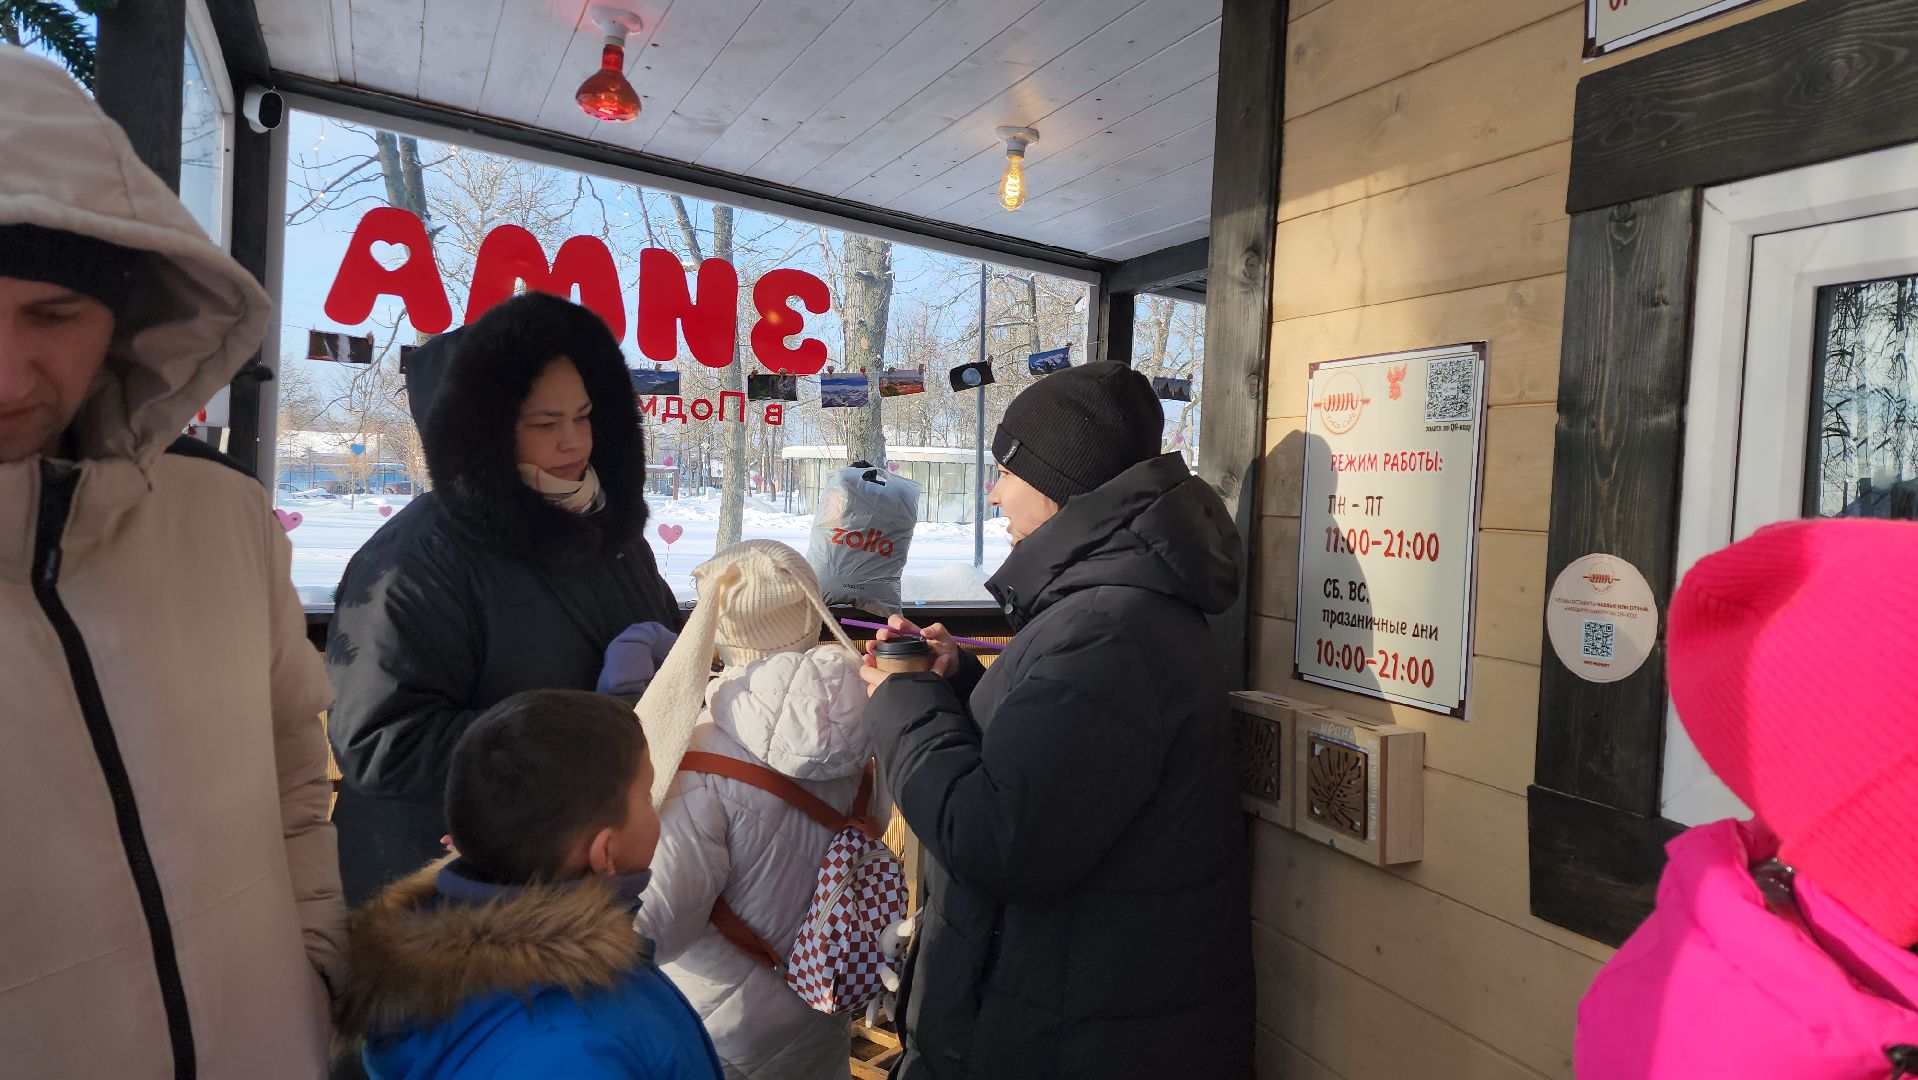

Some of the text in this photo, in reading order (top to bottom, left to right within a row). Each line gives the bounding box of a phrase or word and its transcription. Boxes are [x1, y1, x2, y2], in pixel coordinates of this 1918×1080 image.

[1330, 451, 1443, 473] РЕЖИМ РАБОТЫ:
[1327, 494, 1346, 516] ПН
[1365, 495, 1384, 517] ПТ
[831, 527, 894, 558] zolla
[1324, 526, 1440, 562] 11:00-21:00
[1322, 608, 1439, 641] праздничные дни
[1316, 638, 1435, 688] 10:00-21:00
